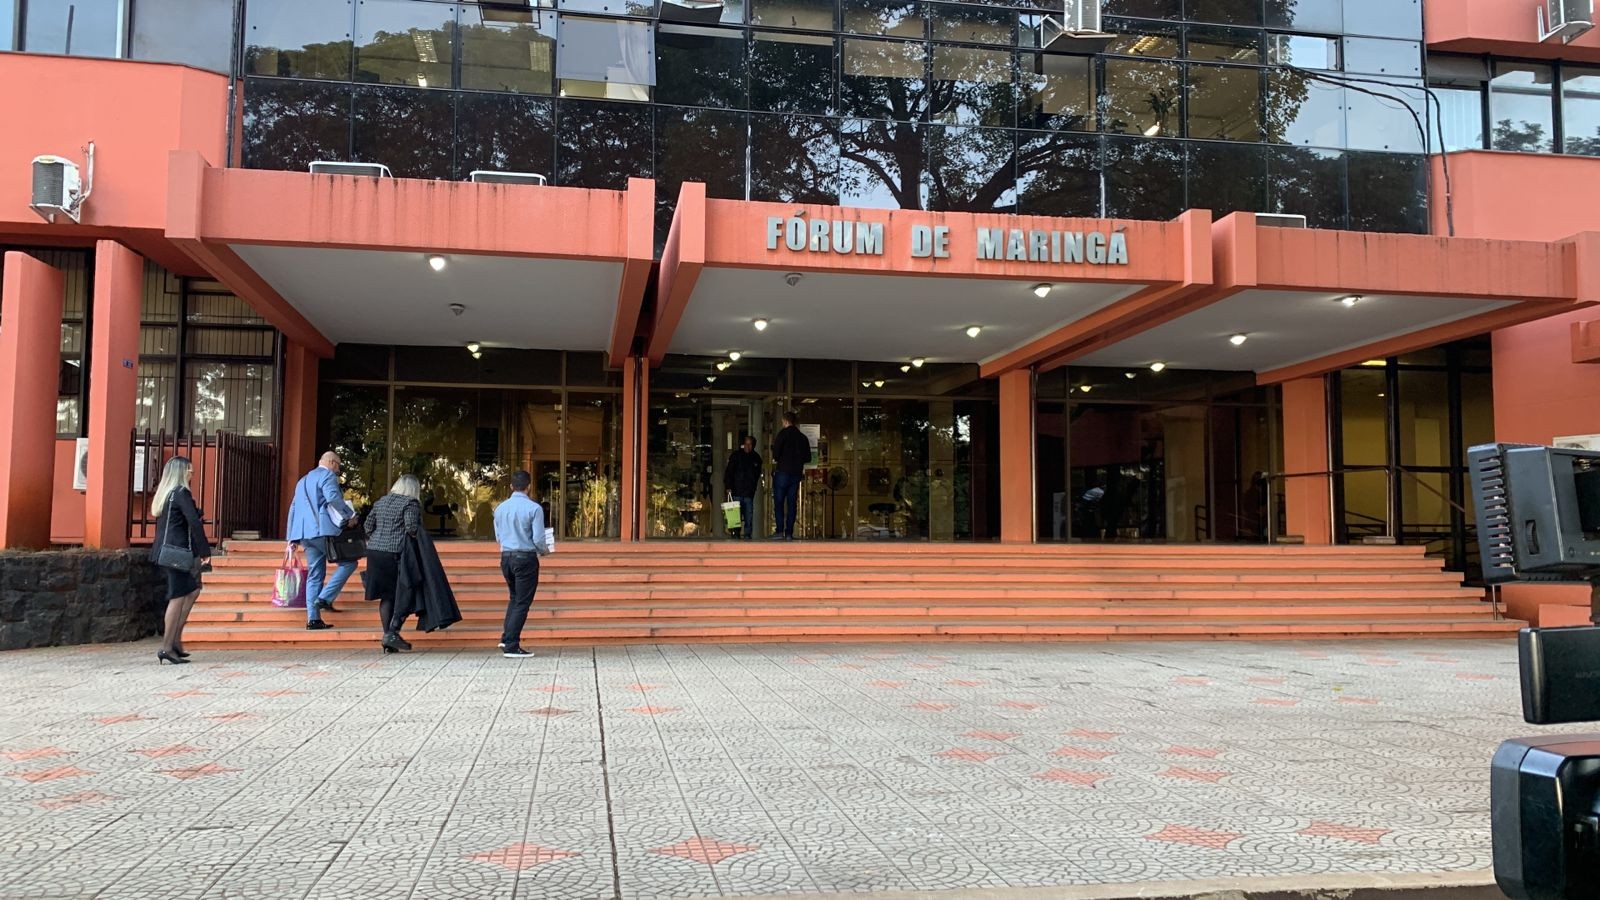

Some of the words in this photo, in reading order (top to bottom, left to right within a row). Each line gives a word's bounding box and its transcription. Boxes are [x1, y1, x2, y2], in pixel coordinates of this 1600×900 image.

[766, 210, 884, 256] FÓRUM
[911, 225, 950, 259] DE
[976, 225, 1129, 265] MARINGÁ
